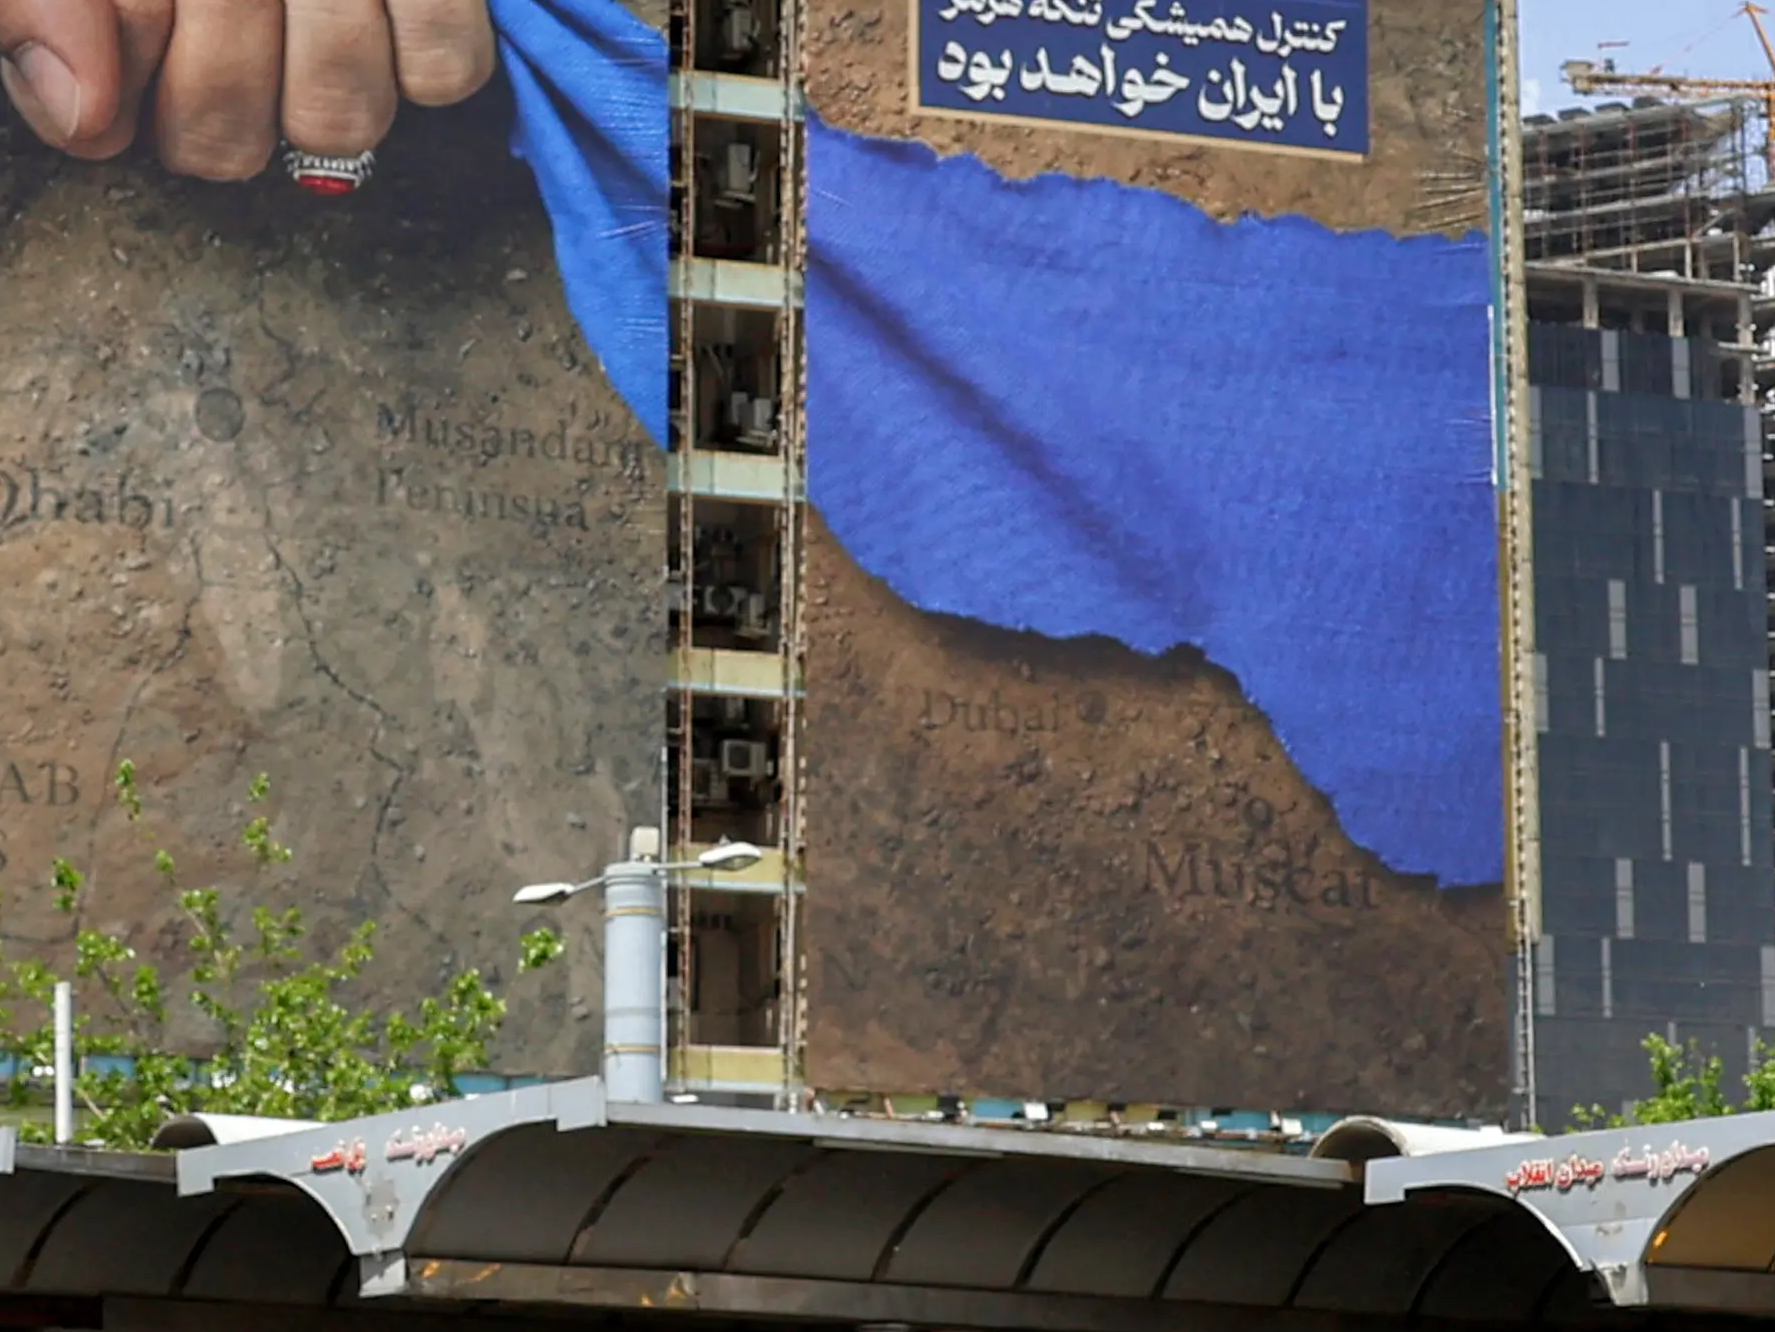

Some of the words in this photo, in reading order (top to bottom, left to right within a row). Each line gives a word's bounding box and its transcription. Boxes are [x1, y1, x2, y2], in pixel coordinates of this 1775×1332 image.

[1255, 11, 1346, 57] کنترل
[937, 42, 1013, 101] بود
[1019, 44, 1190, 117] خواهد
[1198, 58, 1297, 131] ایران
[1311, 69, 1344, 137] با
[1140, 840, 1380, 910] Muscat
